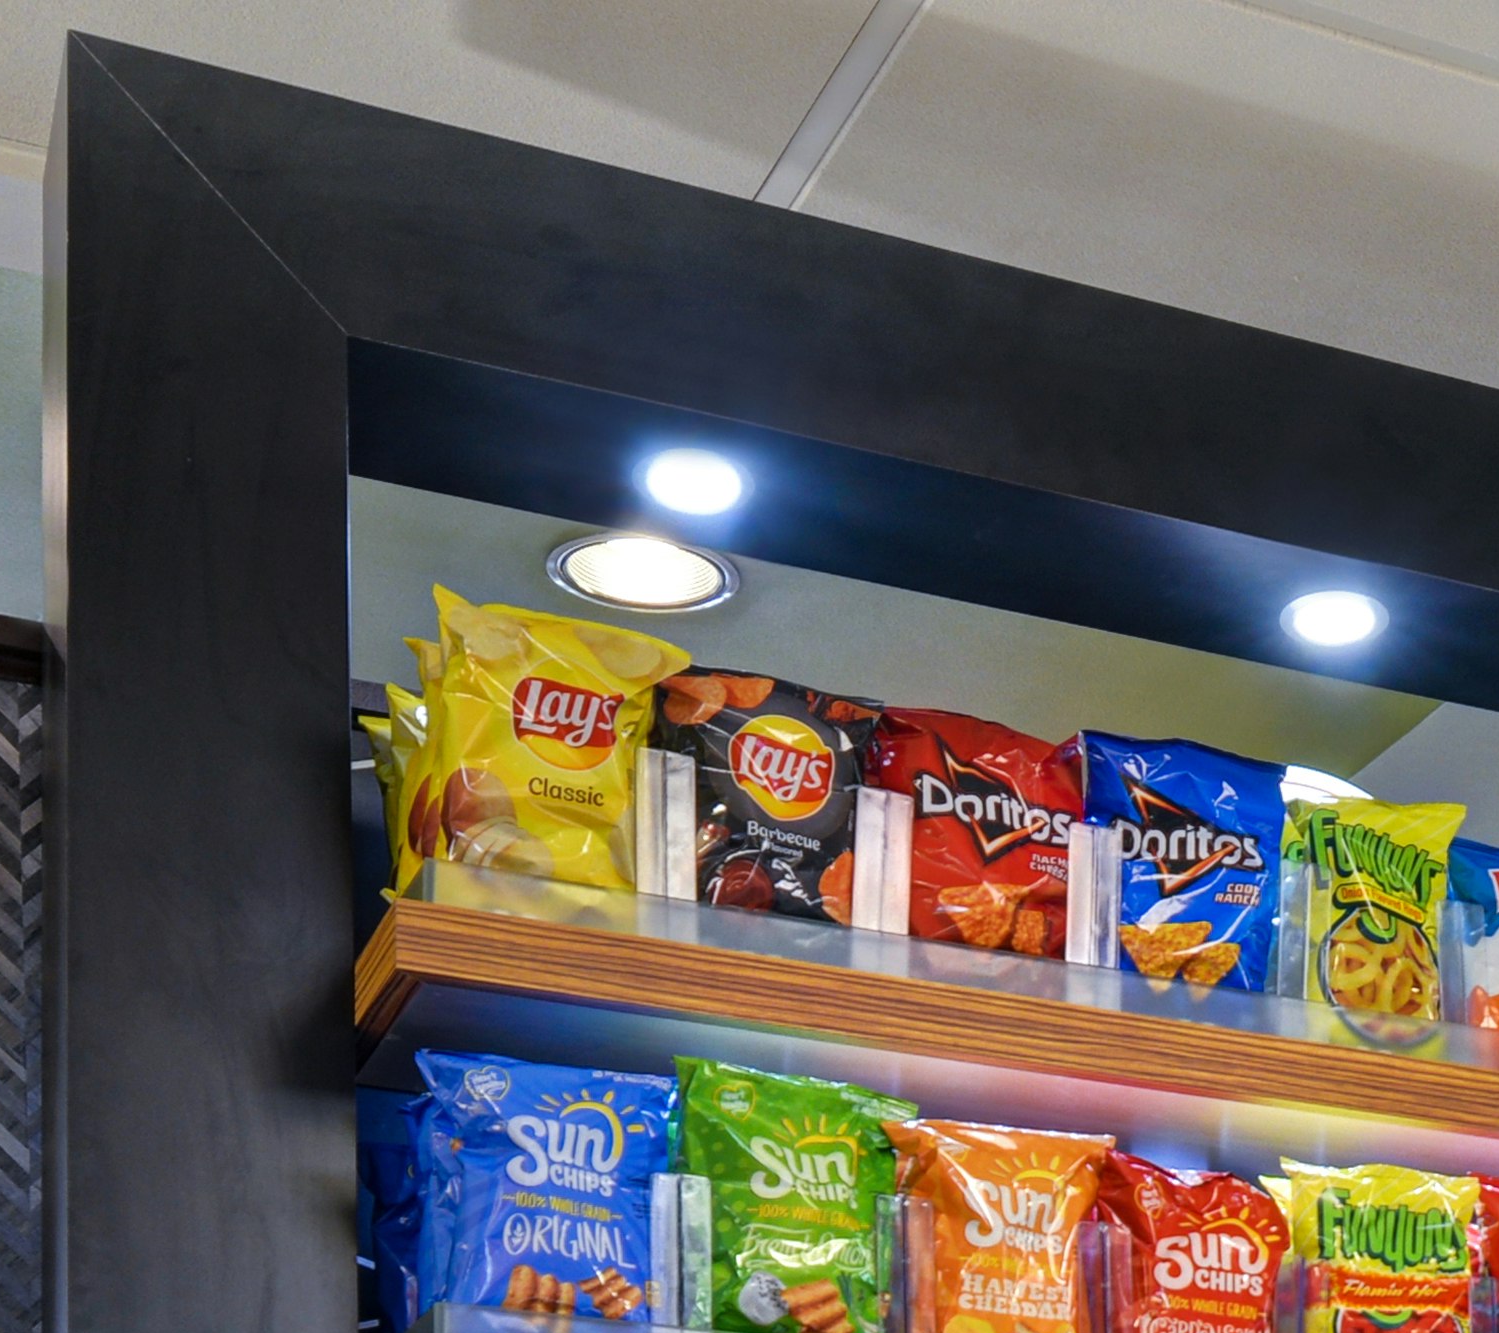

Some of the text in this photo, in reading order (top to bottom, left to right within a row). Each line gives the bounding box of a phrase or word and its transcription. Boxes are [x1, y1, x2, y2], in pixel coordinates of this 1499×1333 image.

[518, 676, 620, 748] Lay's
[528, 776, 605, 807] Classic
[735, 733, 828, 801] Lay's
[746, 819, 822, 852] Barbecue
[920, 772, 1071, 848] Doritos
[1032, 853, 1069, 868] NACH
[1116, 818, 1264, 868] Doritos
[505, 1114, 622, 1188] Sun
[750, 1136, 857, 1199] Sun
[550, 1168, 614, 1197] CHIPS
[502, 1212, 637, 1269] ORIGINAL
[964, 1179, 1065, 1248] Sun
[1005, 1226, 1063, 1254] CHIPS
[1318, 1187, 1469, 1275] FUNYUNS
[1154, 1232, 1269, 1291] Sun
[1194, 1269, 1264, 1296] CHIPS
[1408, 1281, 1448, 1298] Hot
